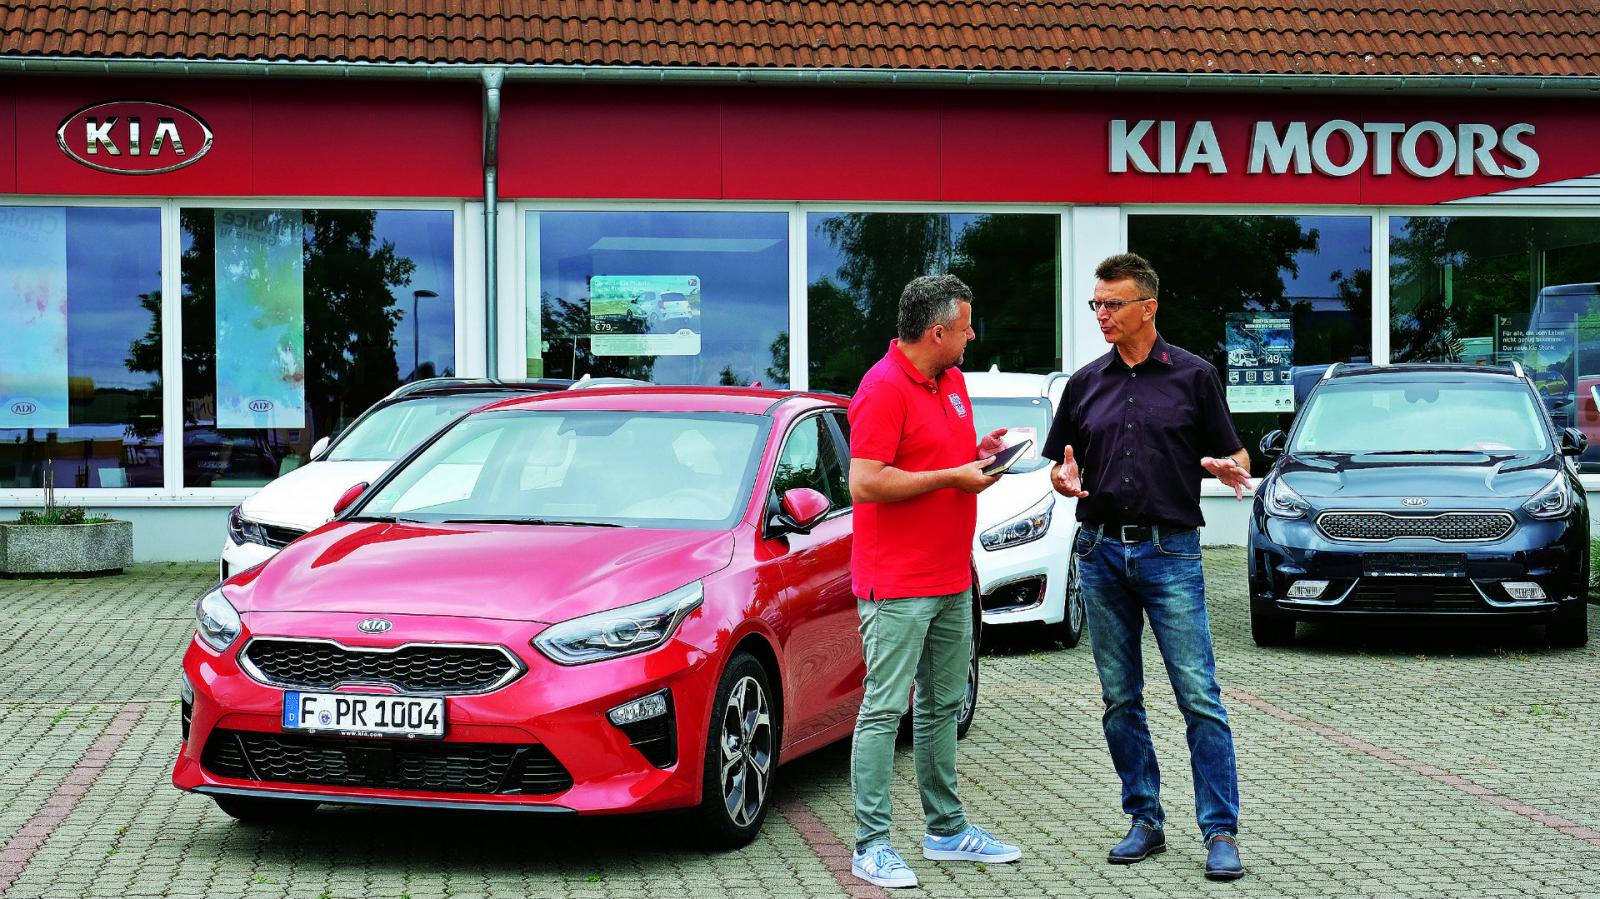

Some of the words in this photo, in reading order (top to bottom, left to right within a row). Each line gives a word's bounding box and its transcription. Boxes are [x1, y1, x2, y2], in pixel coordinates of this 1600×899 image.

[84, 117, 186, 156] KIA
[1108, 119, 1228, 174] KIA
[1246, 119, 1540, 179] MOTORS
[362, 620, 386, 630] KIA
[301, 697, 318, 724] F
[336, 698, 368, 727] PR
[374, 700, 438, 730] 1004
